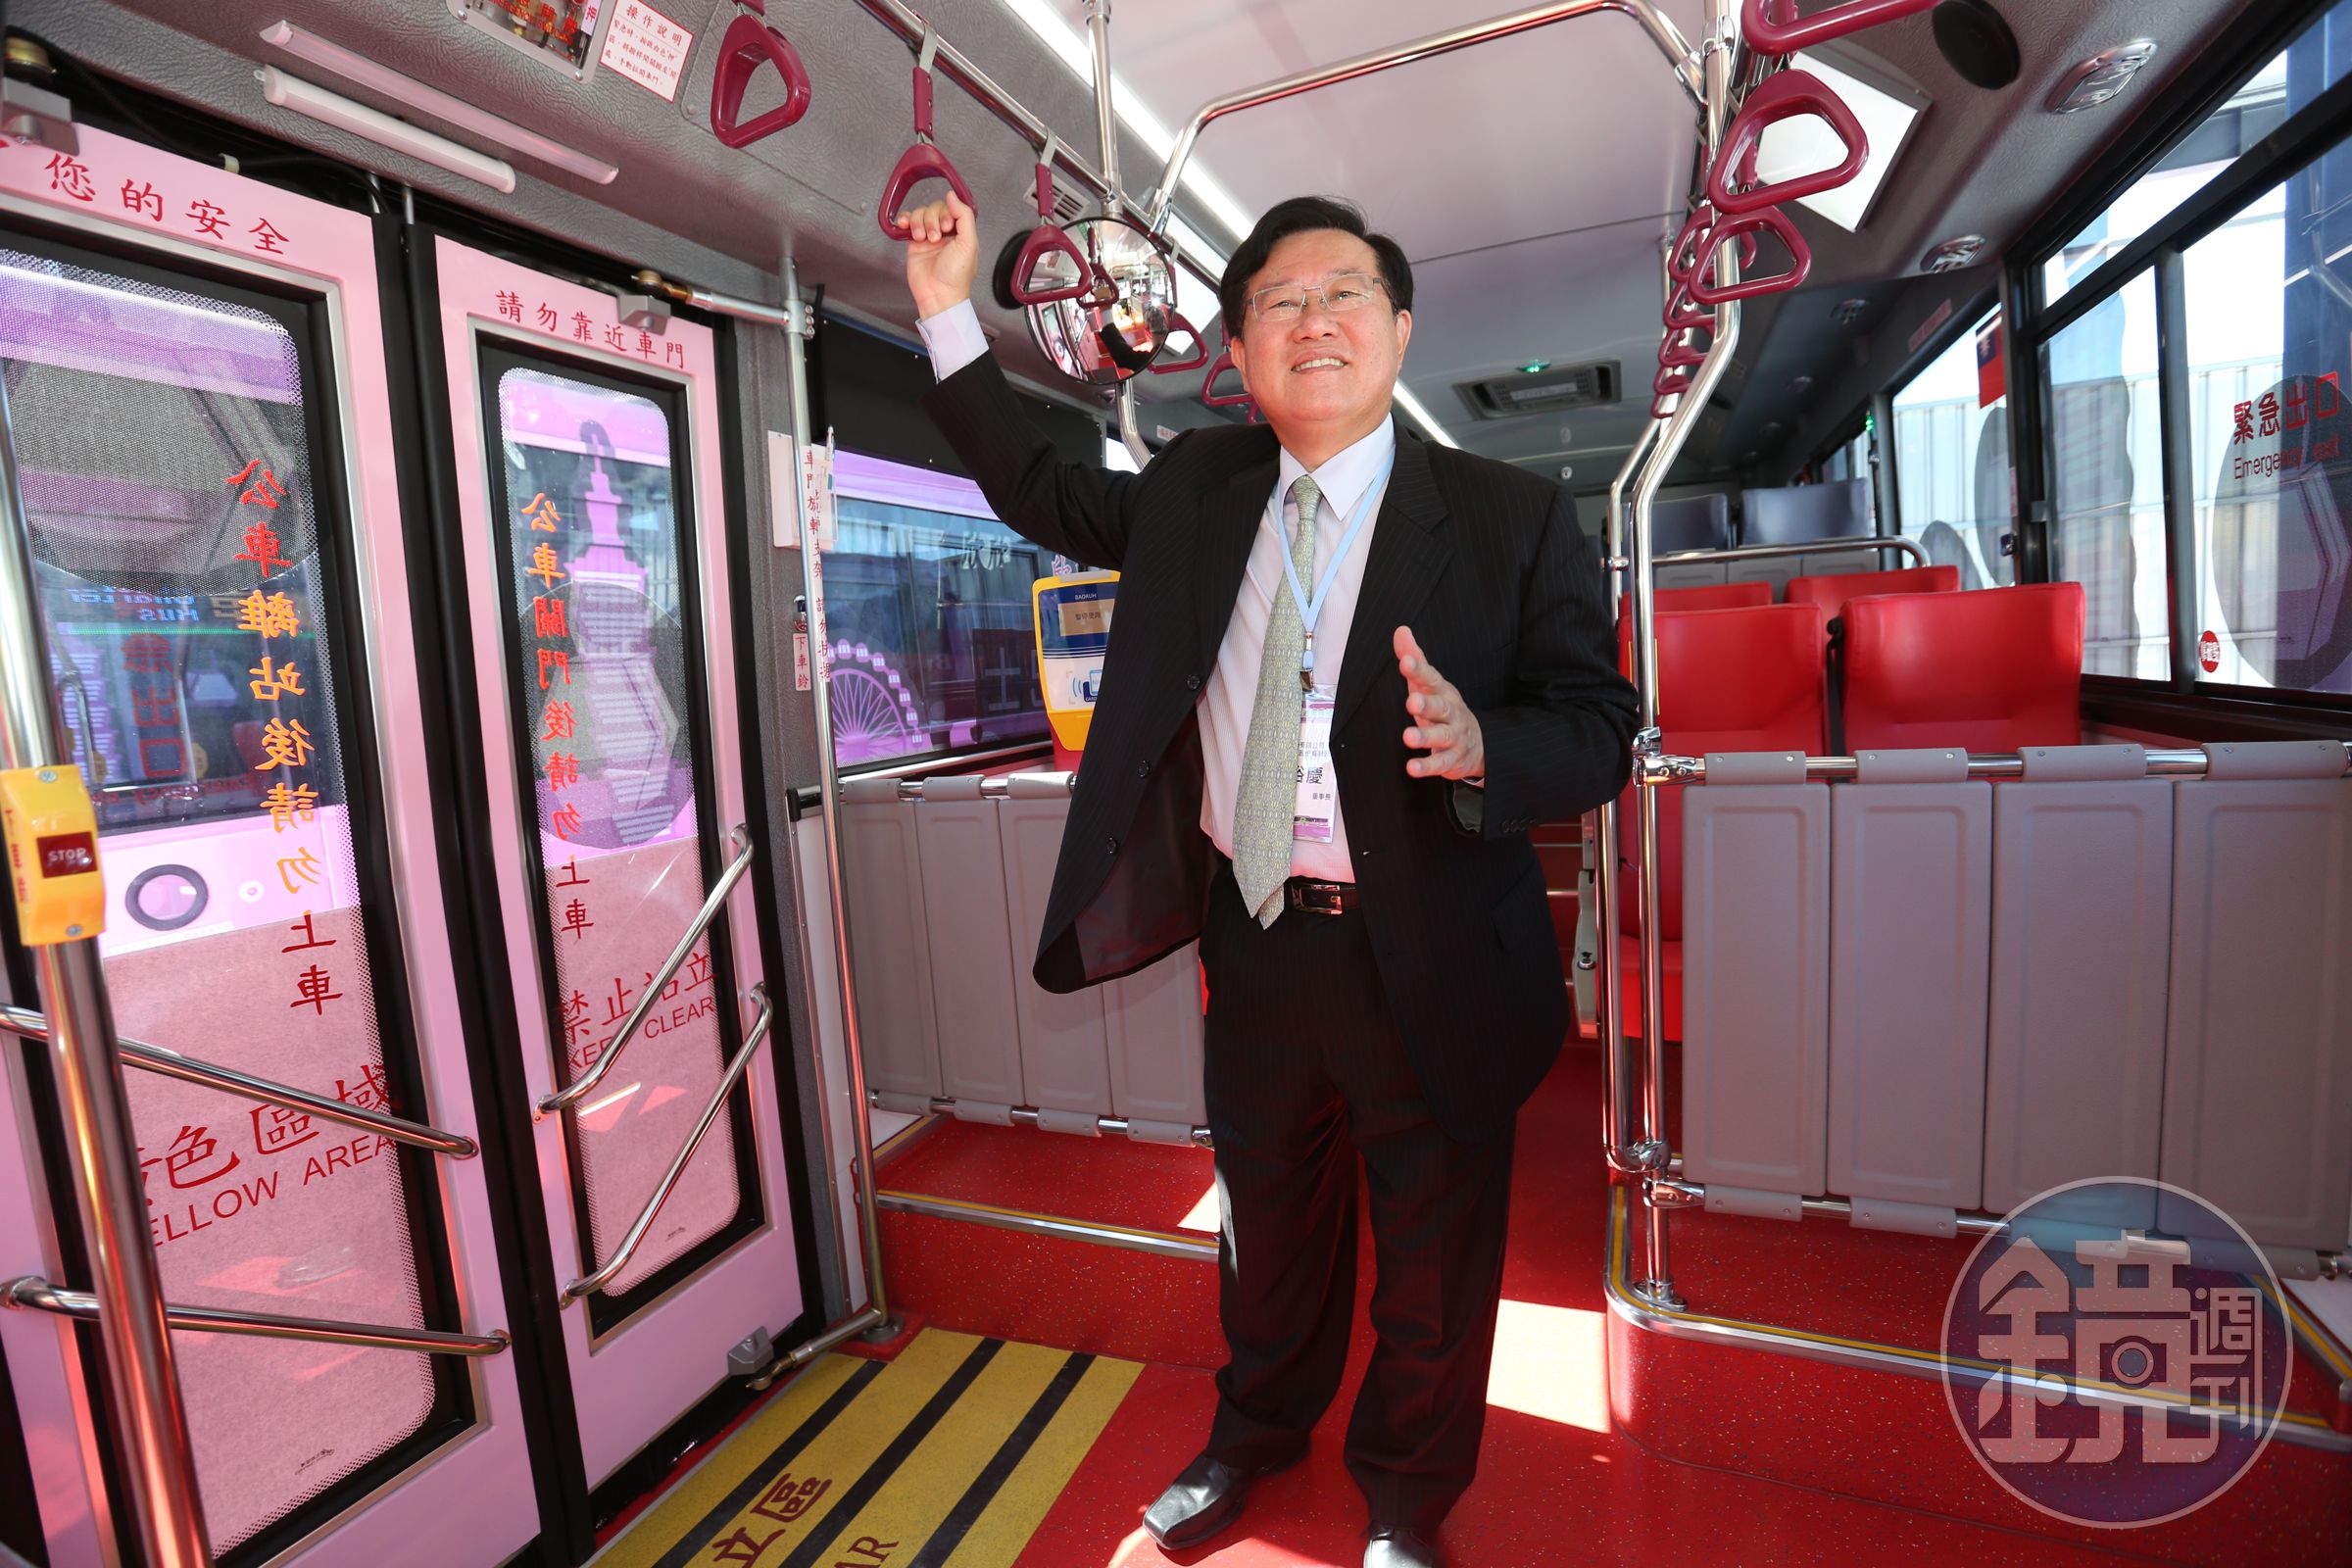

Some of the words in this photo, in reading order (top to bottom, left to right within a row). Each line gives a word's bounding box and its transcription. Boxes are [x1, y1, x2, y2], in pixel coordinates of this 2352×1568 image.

[626, 4, 683, 47] 操作說明
[496, 290, 684, 369] 請勿靠近車門
[2233, 371, 2340, 446] 緊急出口
[2233, 446, 2304, 480] Emergency
[795, 636, 809, 688] 下車鈴
[48, 847, 87, 862] STOP
[644, 996, 715, 1040] CLEAR
[834, 1536, 900, 1568] R
